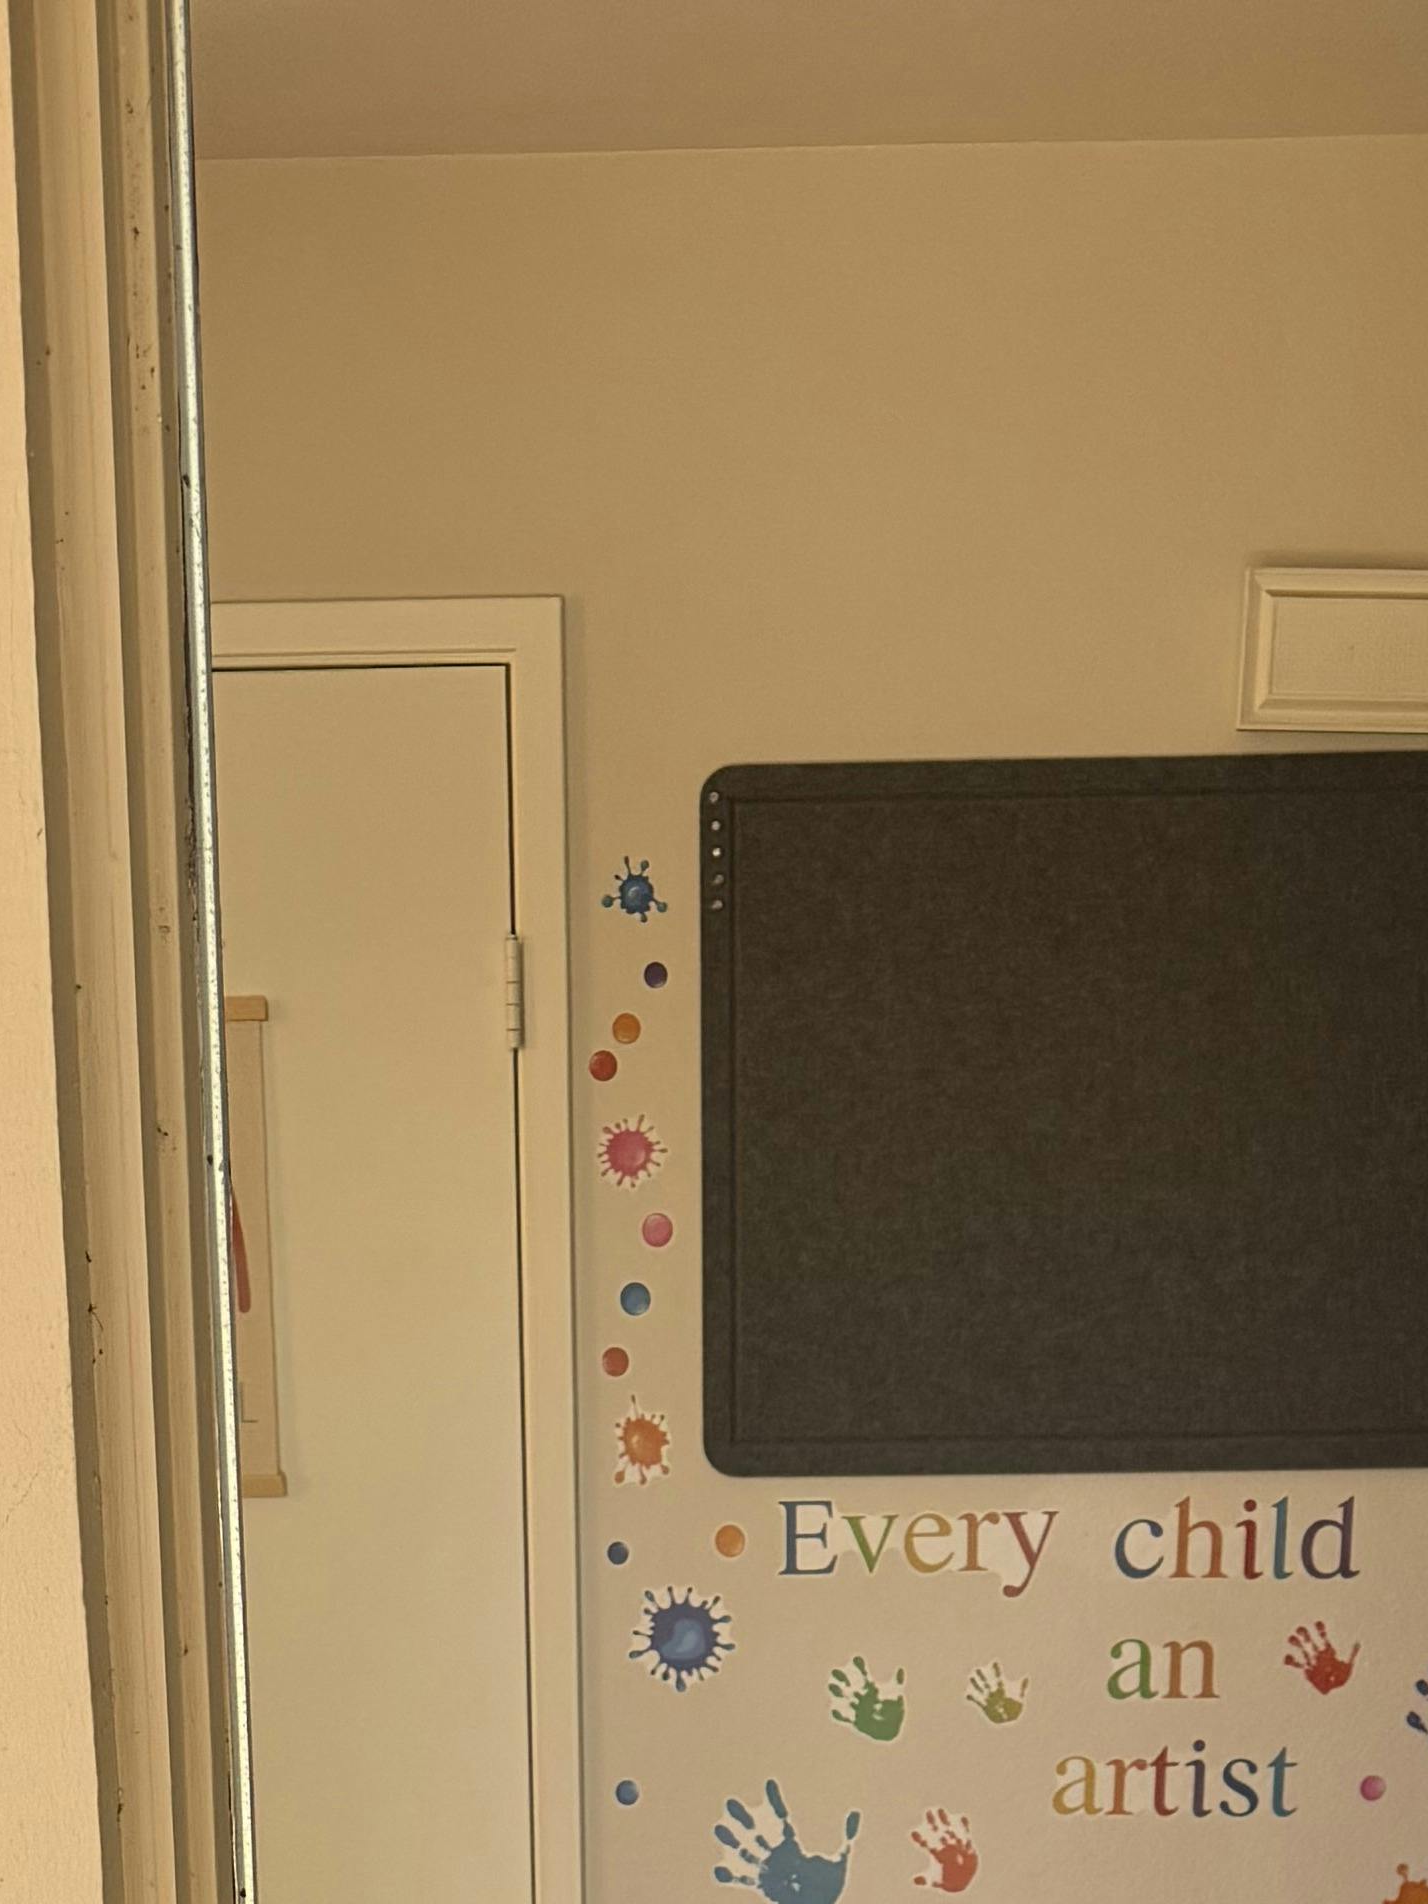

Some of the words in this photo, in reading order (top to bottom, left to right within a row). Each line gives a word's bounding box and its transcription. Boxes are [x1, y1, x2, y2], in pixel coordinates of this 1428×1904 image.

[777, 1499, 1061, 1598] Every
[1114, 1496, 1360, 1580] child
[1107, 1638, 1221, 1700] an
[1052, 1739, 1299, 1818] artist
